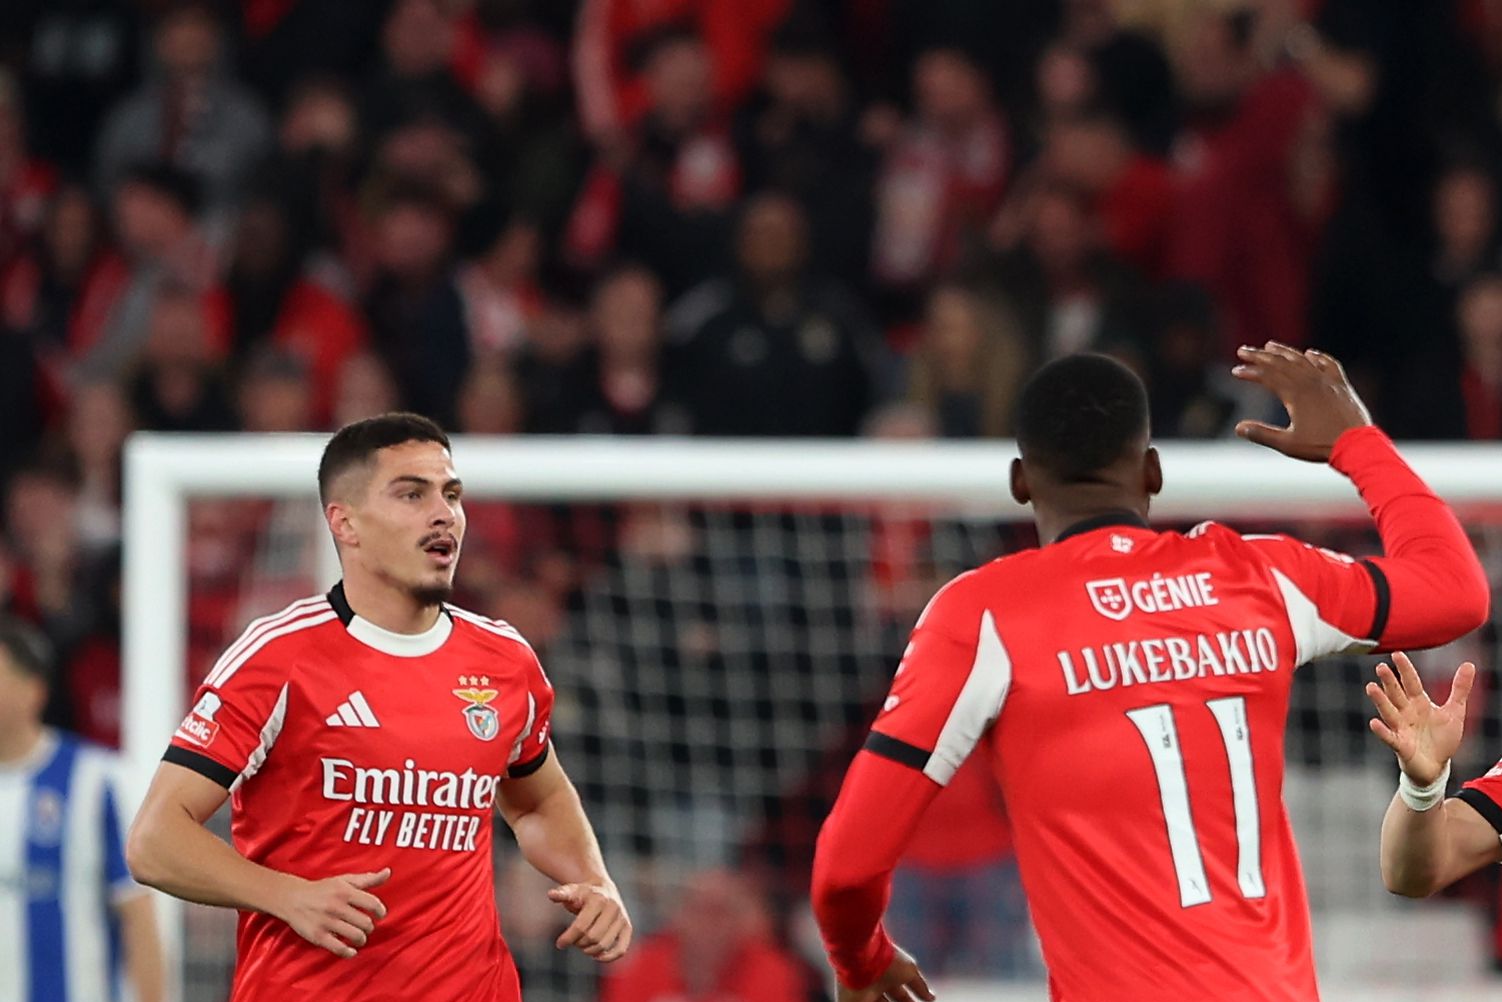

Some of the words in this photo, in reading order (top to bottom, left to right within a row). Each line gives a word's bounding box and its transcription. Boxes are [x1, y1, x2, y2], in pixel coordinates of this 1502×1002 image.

[1131, 572, 1219, 613] GÉNIE
[1057, 627, 1278, 695] LUKEBAKIO
[343, 807, 394, 846] FLY
[396, 811, 480, 851] BETTER
[1126, 697, 1265, 908] 11
